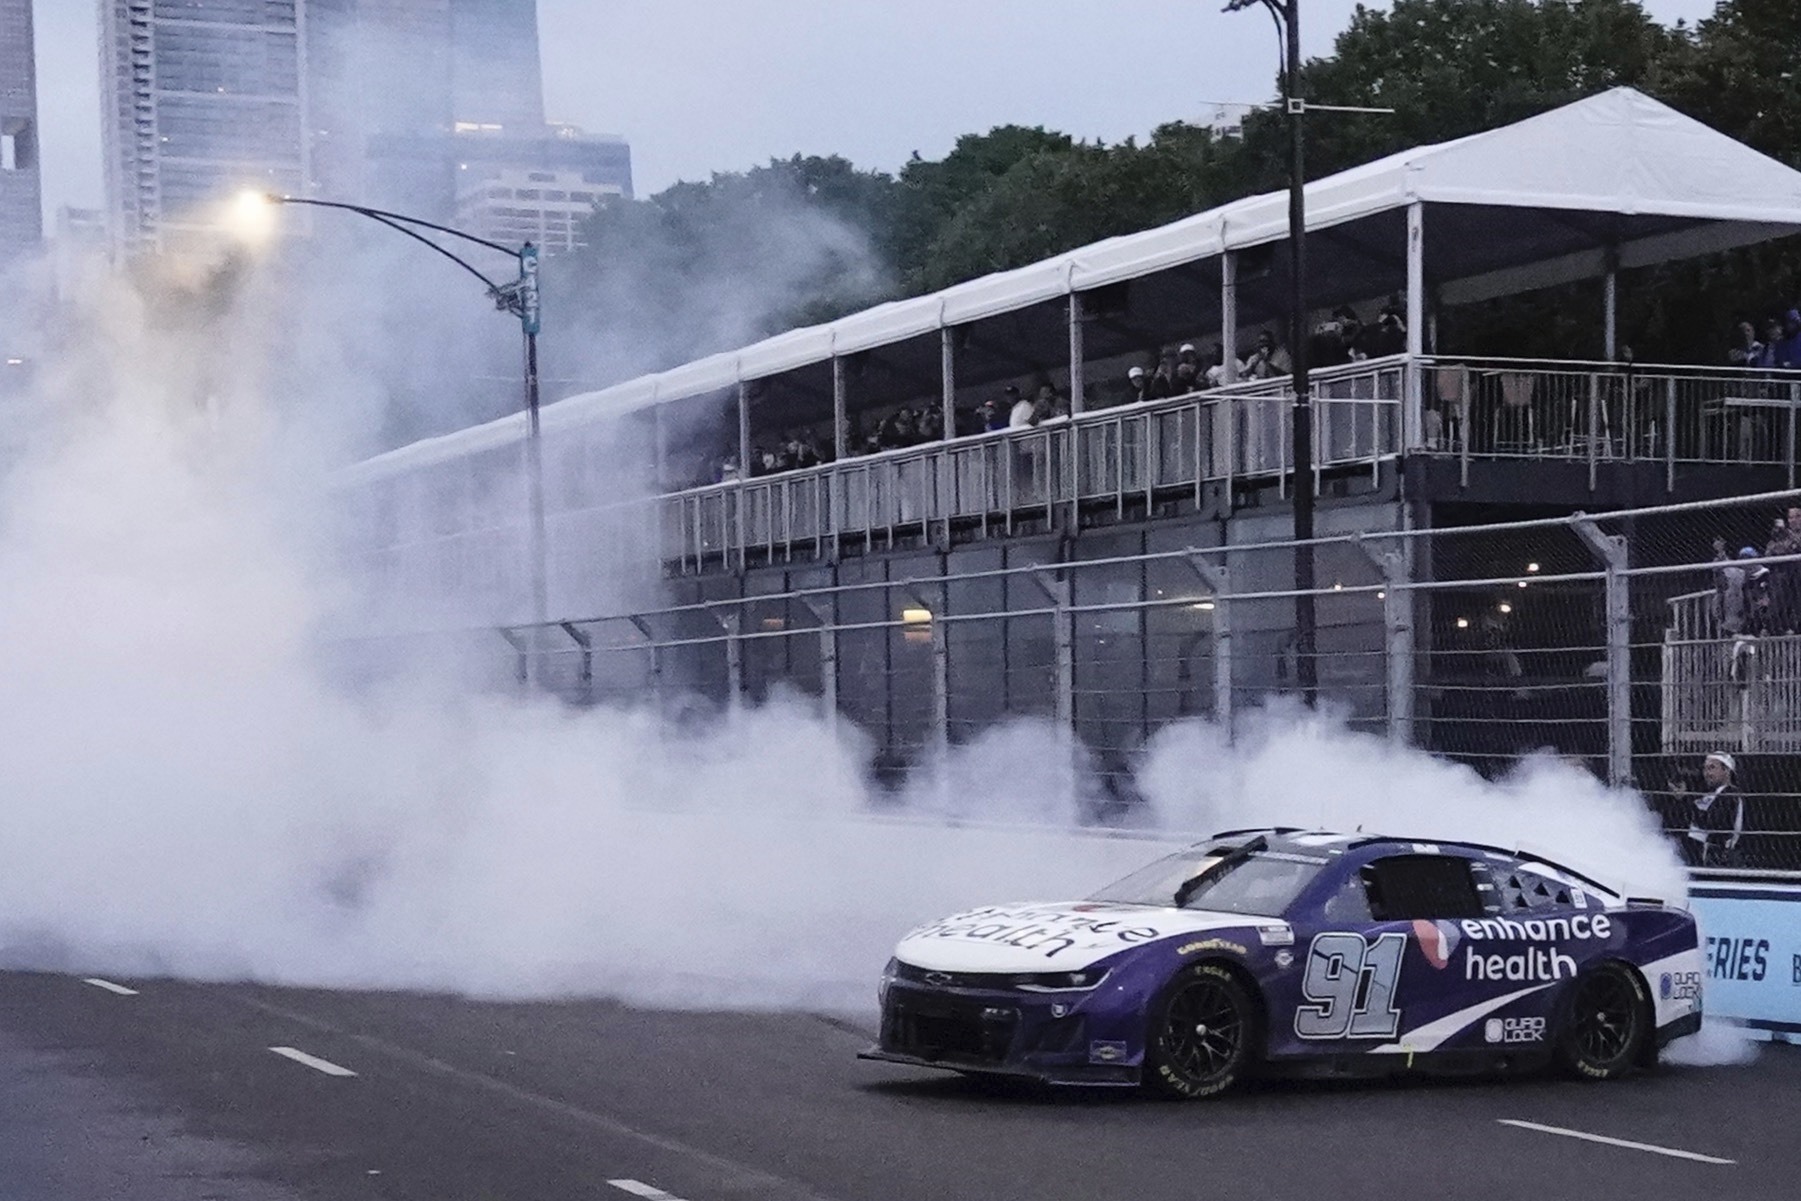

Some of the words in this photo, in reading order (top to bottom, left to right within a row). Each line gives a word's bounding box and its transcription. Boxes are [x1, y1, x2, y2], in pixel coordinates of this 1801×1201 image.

[904, 920, 1076, 957] health
[1461, 914, 1611, 941] enhance
[1466, 946, 1577, 980] health
[1294, 931, 1408, 1039] 91
[1503, 1030, 1545, 1043] LOCK
[1504, 1016, 1546, 1030] QUAD
